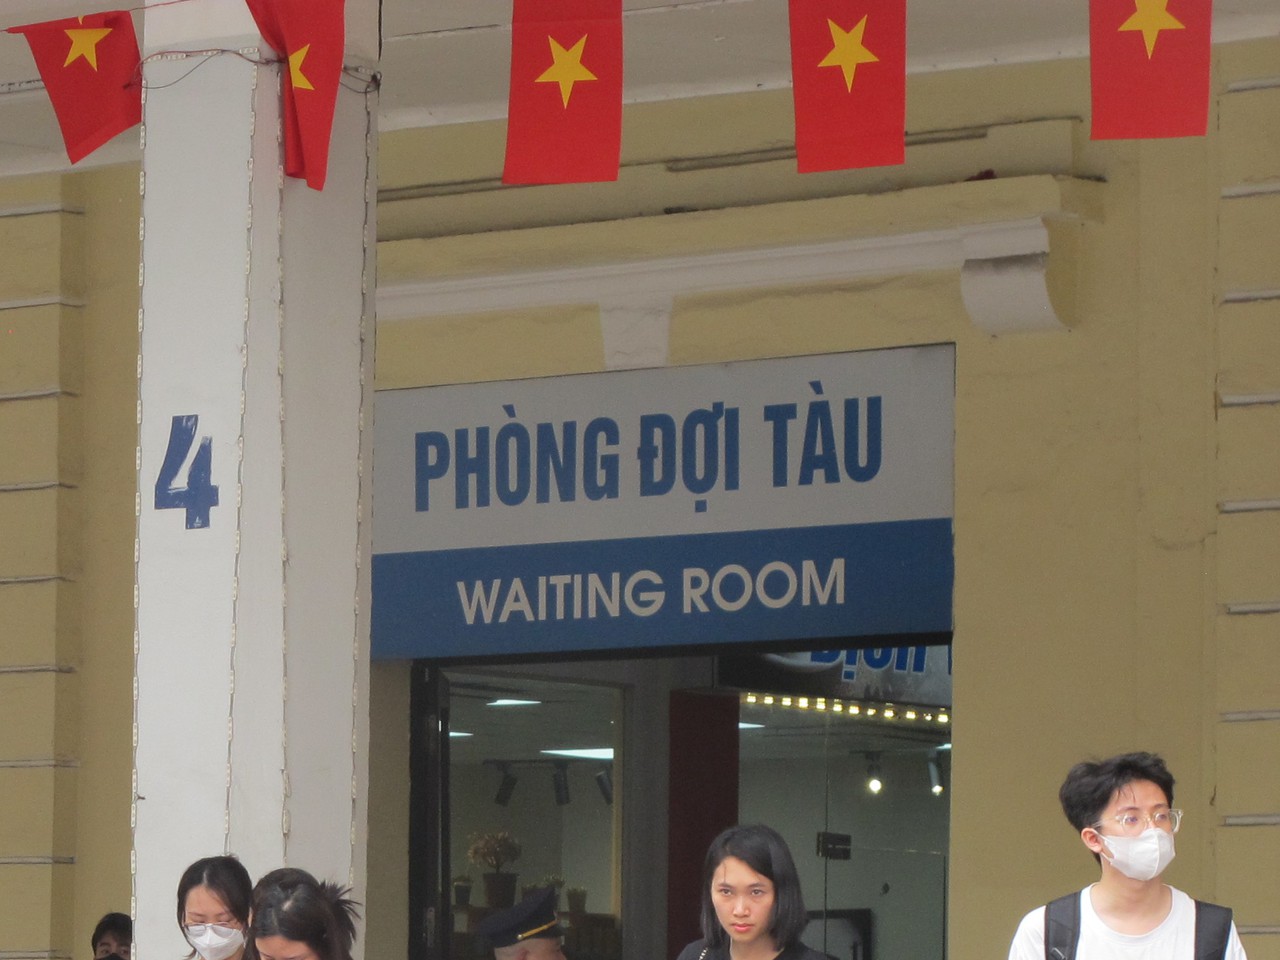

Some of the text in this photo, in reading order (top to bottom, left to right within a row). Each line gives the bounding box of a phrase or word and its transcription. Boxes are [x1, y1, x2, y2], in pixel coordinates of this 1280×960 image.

[154, 414, 219, 530] 4
[415, 380, 882, 513] PHÒNG ĐỢI TÀU
[457, 558, 846, 625] WAITING ROOM
